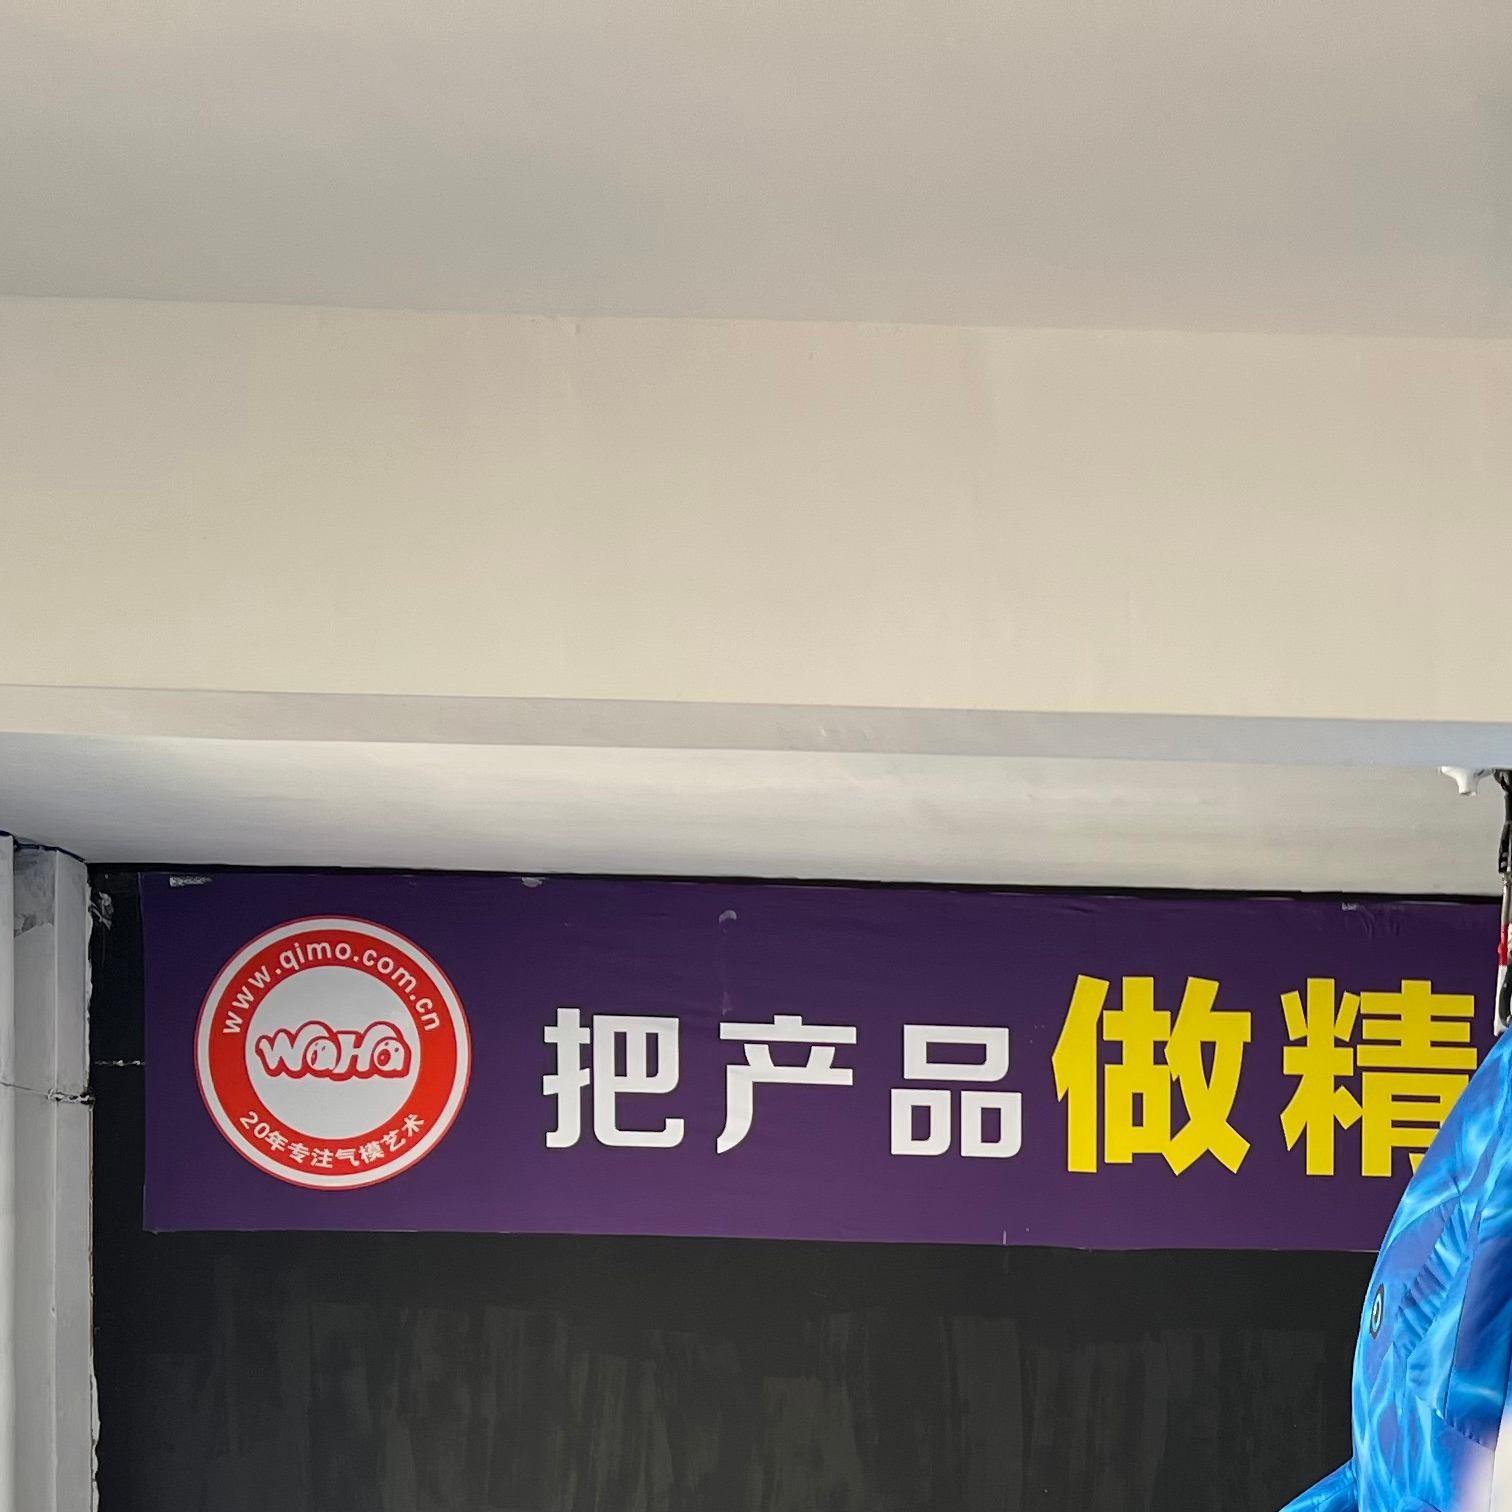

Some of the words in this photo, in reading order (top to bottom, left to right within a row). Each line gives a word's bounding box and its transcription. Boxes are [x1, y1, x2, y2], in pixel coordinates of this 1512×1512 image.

[223, 942, 441, 1034] www.qimo.com.cn
[239, 1111, 424, 1168] 20年专注气模艺术
